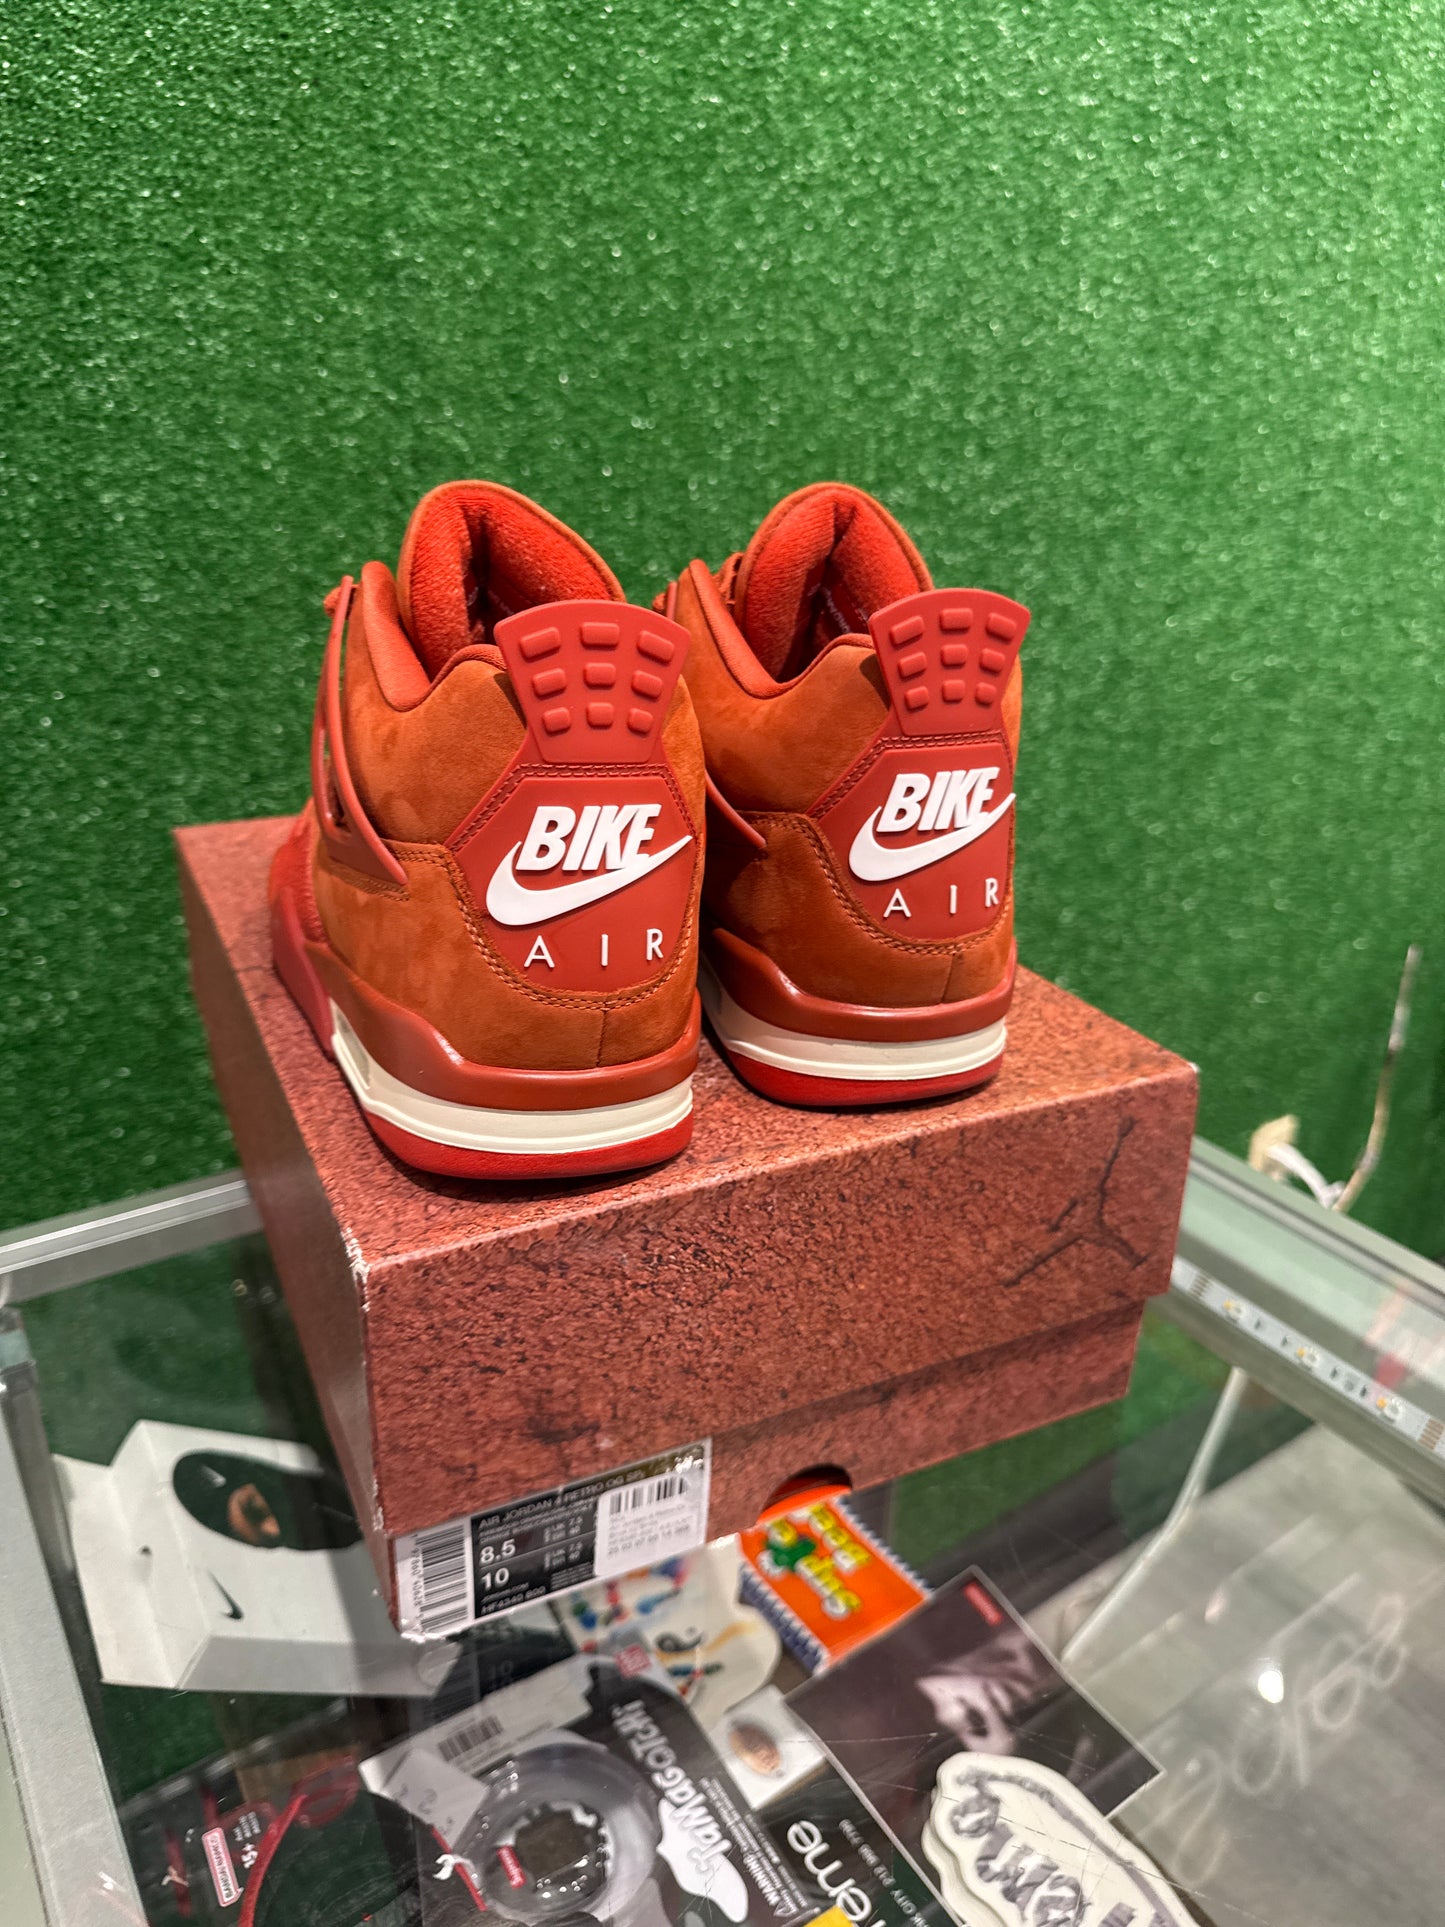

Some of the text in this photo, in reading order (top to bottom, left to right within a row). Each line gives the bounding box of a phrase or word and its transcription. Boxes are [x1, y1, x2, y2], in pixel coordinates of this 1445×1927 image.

[875, 766, 1000, 832] BIKE
[515, 803, 662, 872] BIKE
[883, 877, 1000, 918] AIR
[523, 928, 664, 969] AIR
[479, 1515, 500, 1528] AIR
[502, 1499, 553, 1522] JORDAN
[480, 1538, 516, 1564] 8.5
[482, 1567, 510, 1590] 10
[890, 1888, 917, 1915] CITY
